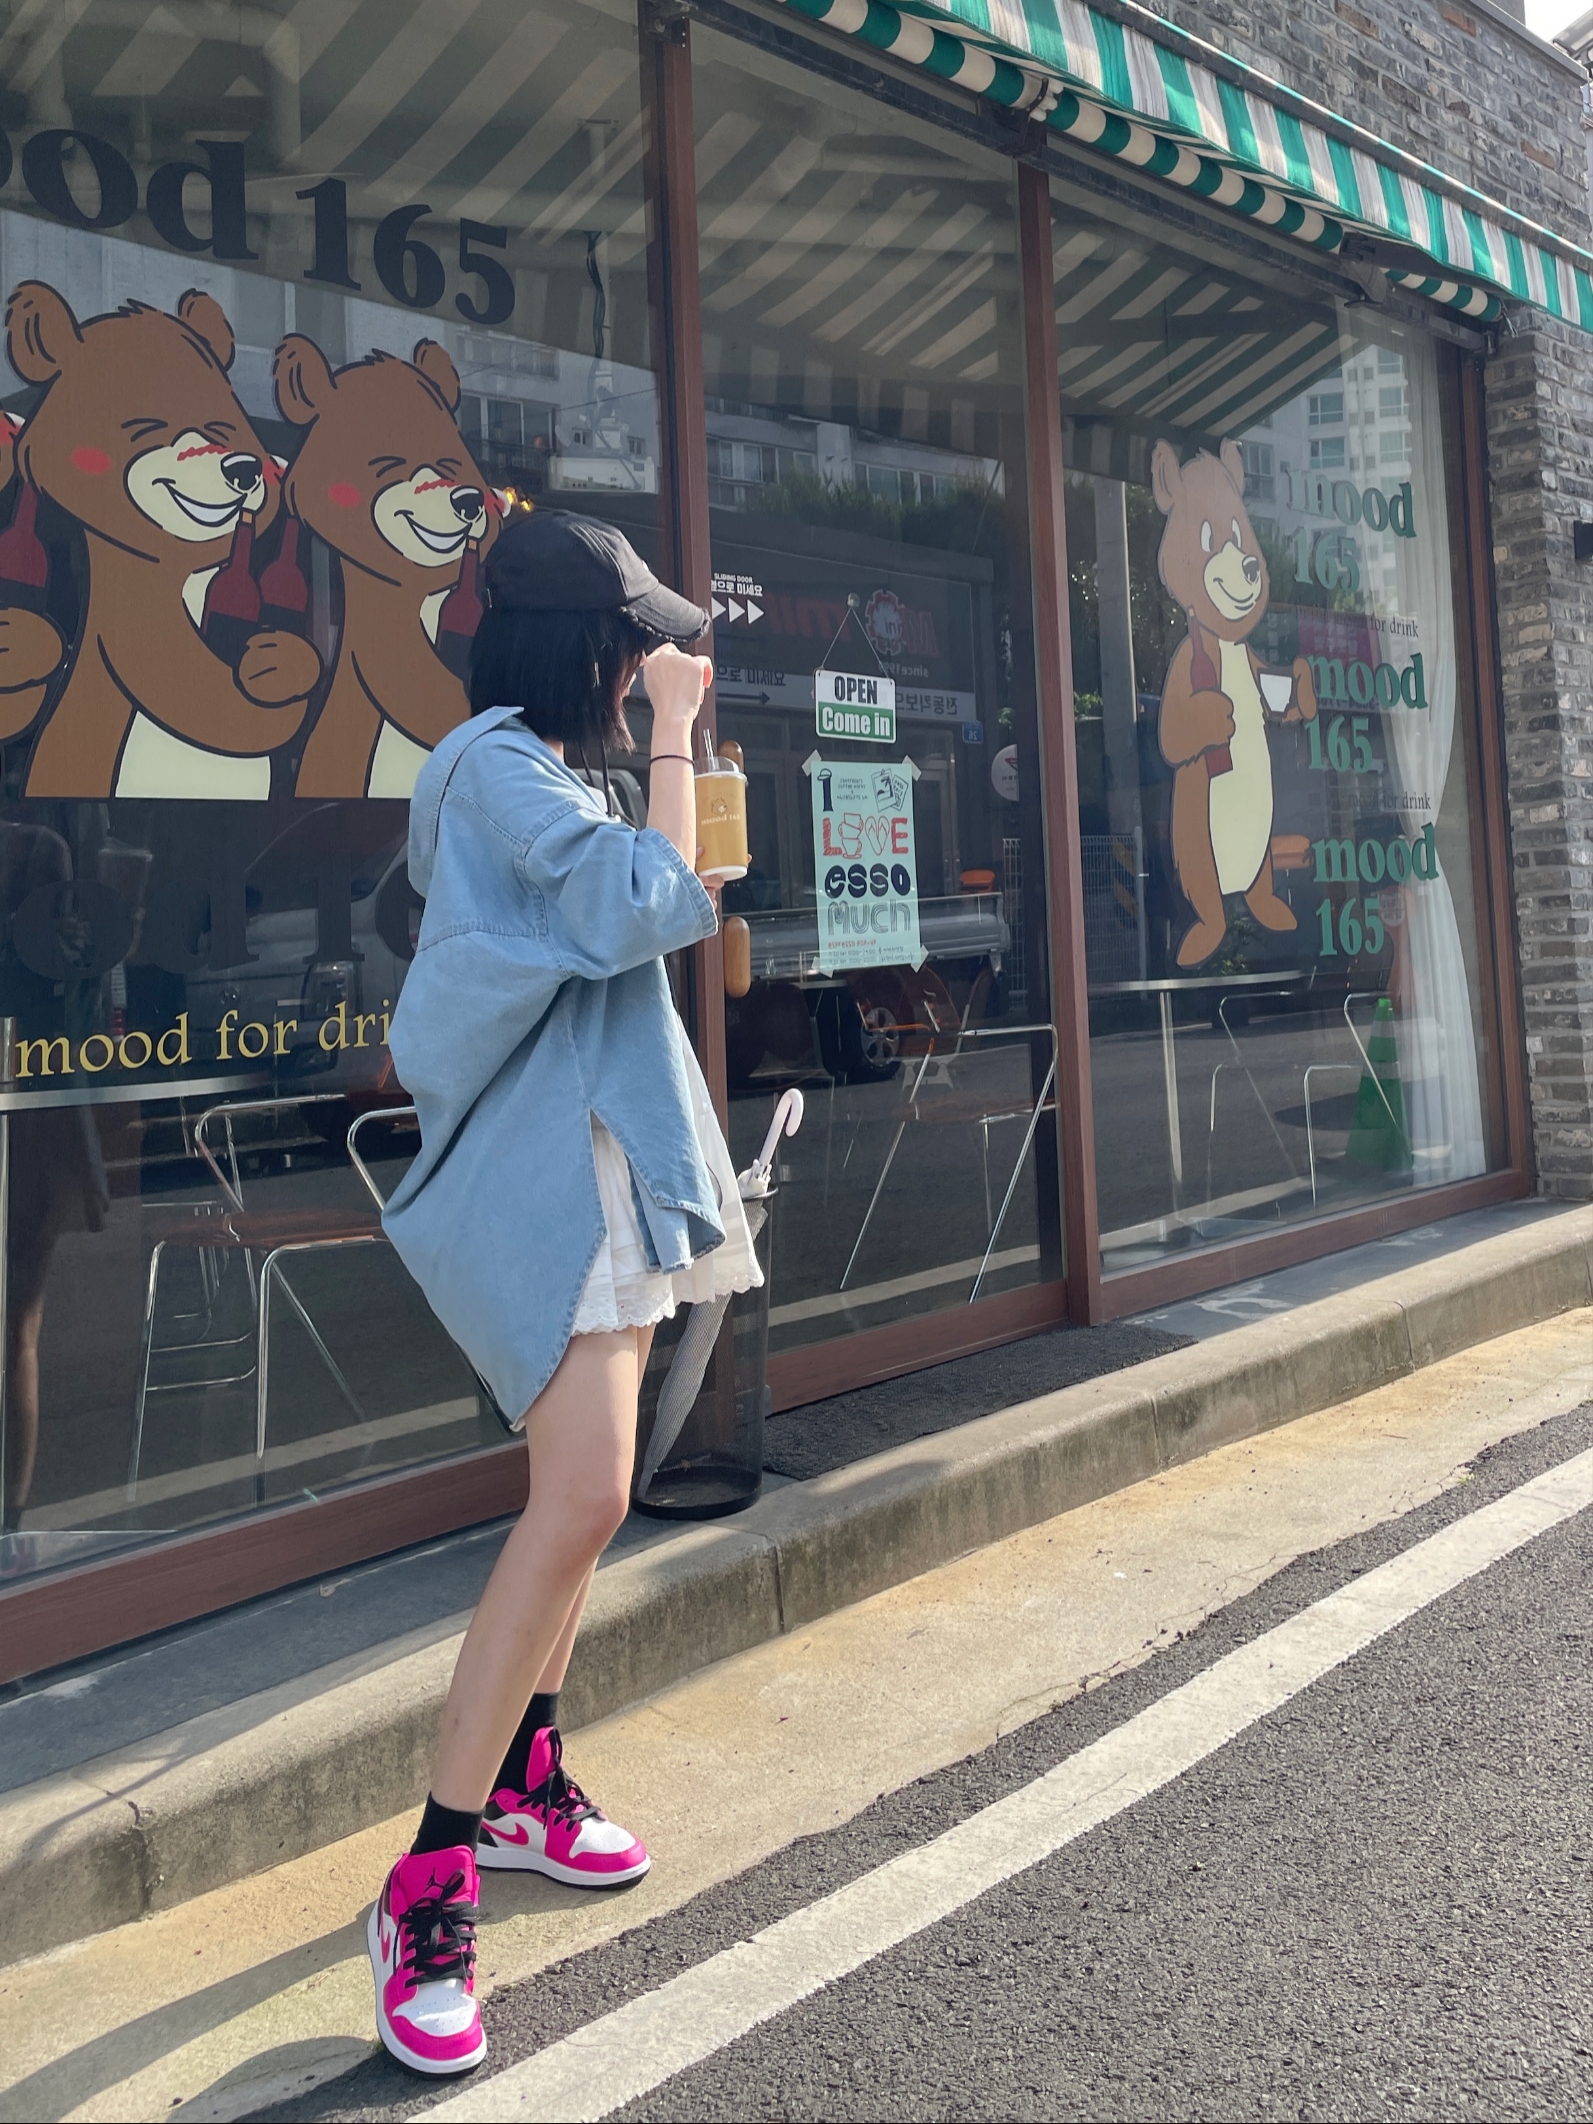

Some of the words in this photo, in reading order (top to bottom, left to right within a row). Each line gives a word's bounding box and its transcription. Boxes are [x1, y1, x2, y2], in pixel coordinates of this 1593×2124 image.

[0, 129, 258, 260] od
[296, 177, 516, 324] 165
[1287, 468, 1417, 538] mood
[714, 573, 736, 582] SLIDING
[737, 575, 753, 583] DOOR
[1293, 526, 1360, 594] 165
[737, 582, 763, 597] 미세요
[1389, 617, 1420, 638] drink
[834, 675, 878, 705] OPEN
[1309, 652, 1429, 710] mood
[822, 706, 871, 734] Come
[874, 711, 891, 738] in
[1305, 713, 1373, 774] 165
[1402, 791, 1431, 809] drink
[1311, 821, 1439, 882] mood
[1316, 898, 1385, 957] 165
[15, 1012, 193, 1079] mood
[216, 1009, 297, 1060] for
